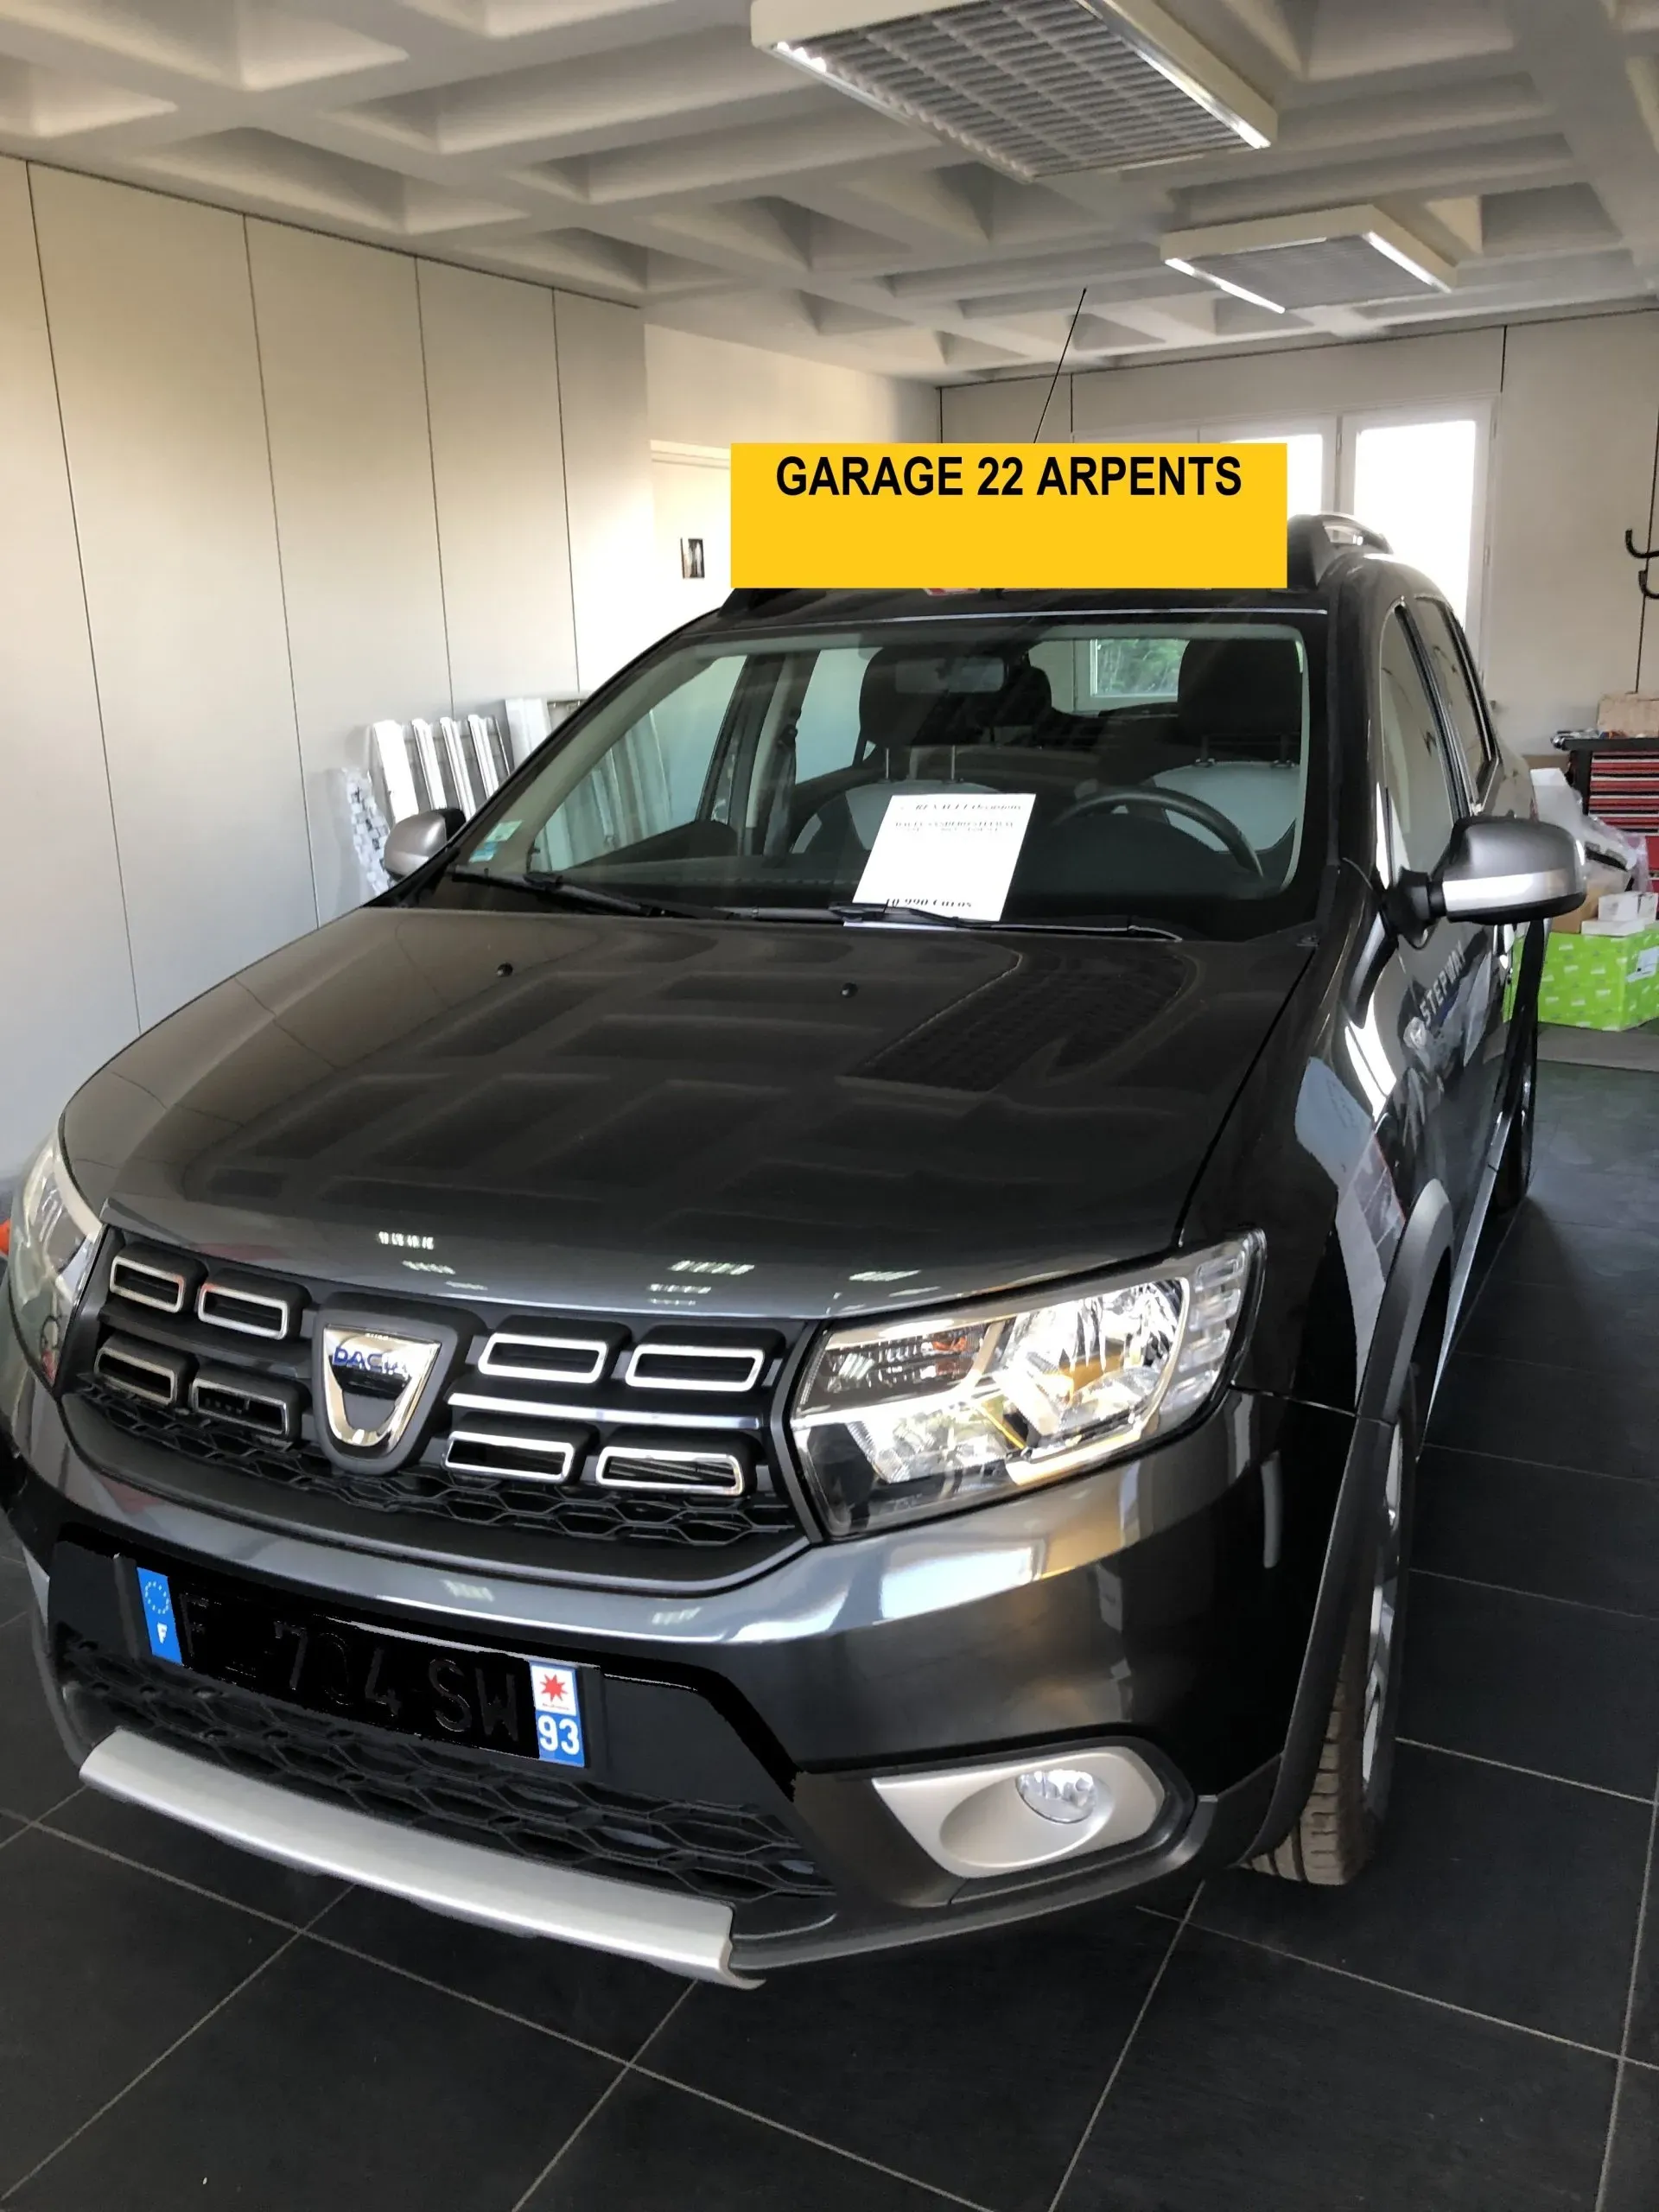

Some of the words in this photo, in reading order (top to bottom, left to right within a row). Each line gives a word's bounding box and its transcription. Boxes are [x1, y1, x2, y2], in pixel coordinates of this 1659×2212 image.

[1419, 938, 1465, 1027] STEPWAY
[156, 1621, 168, 1644] F
[429, 1656, 518, 1741] SW
[537, 1713, 580, 1756] 93
